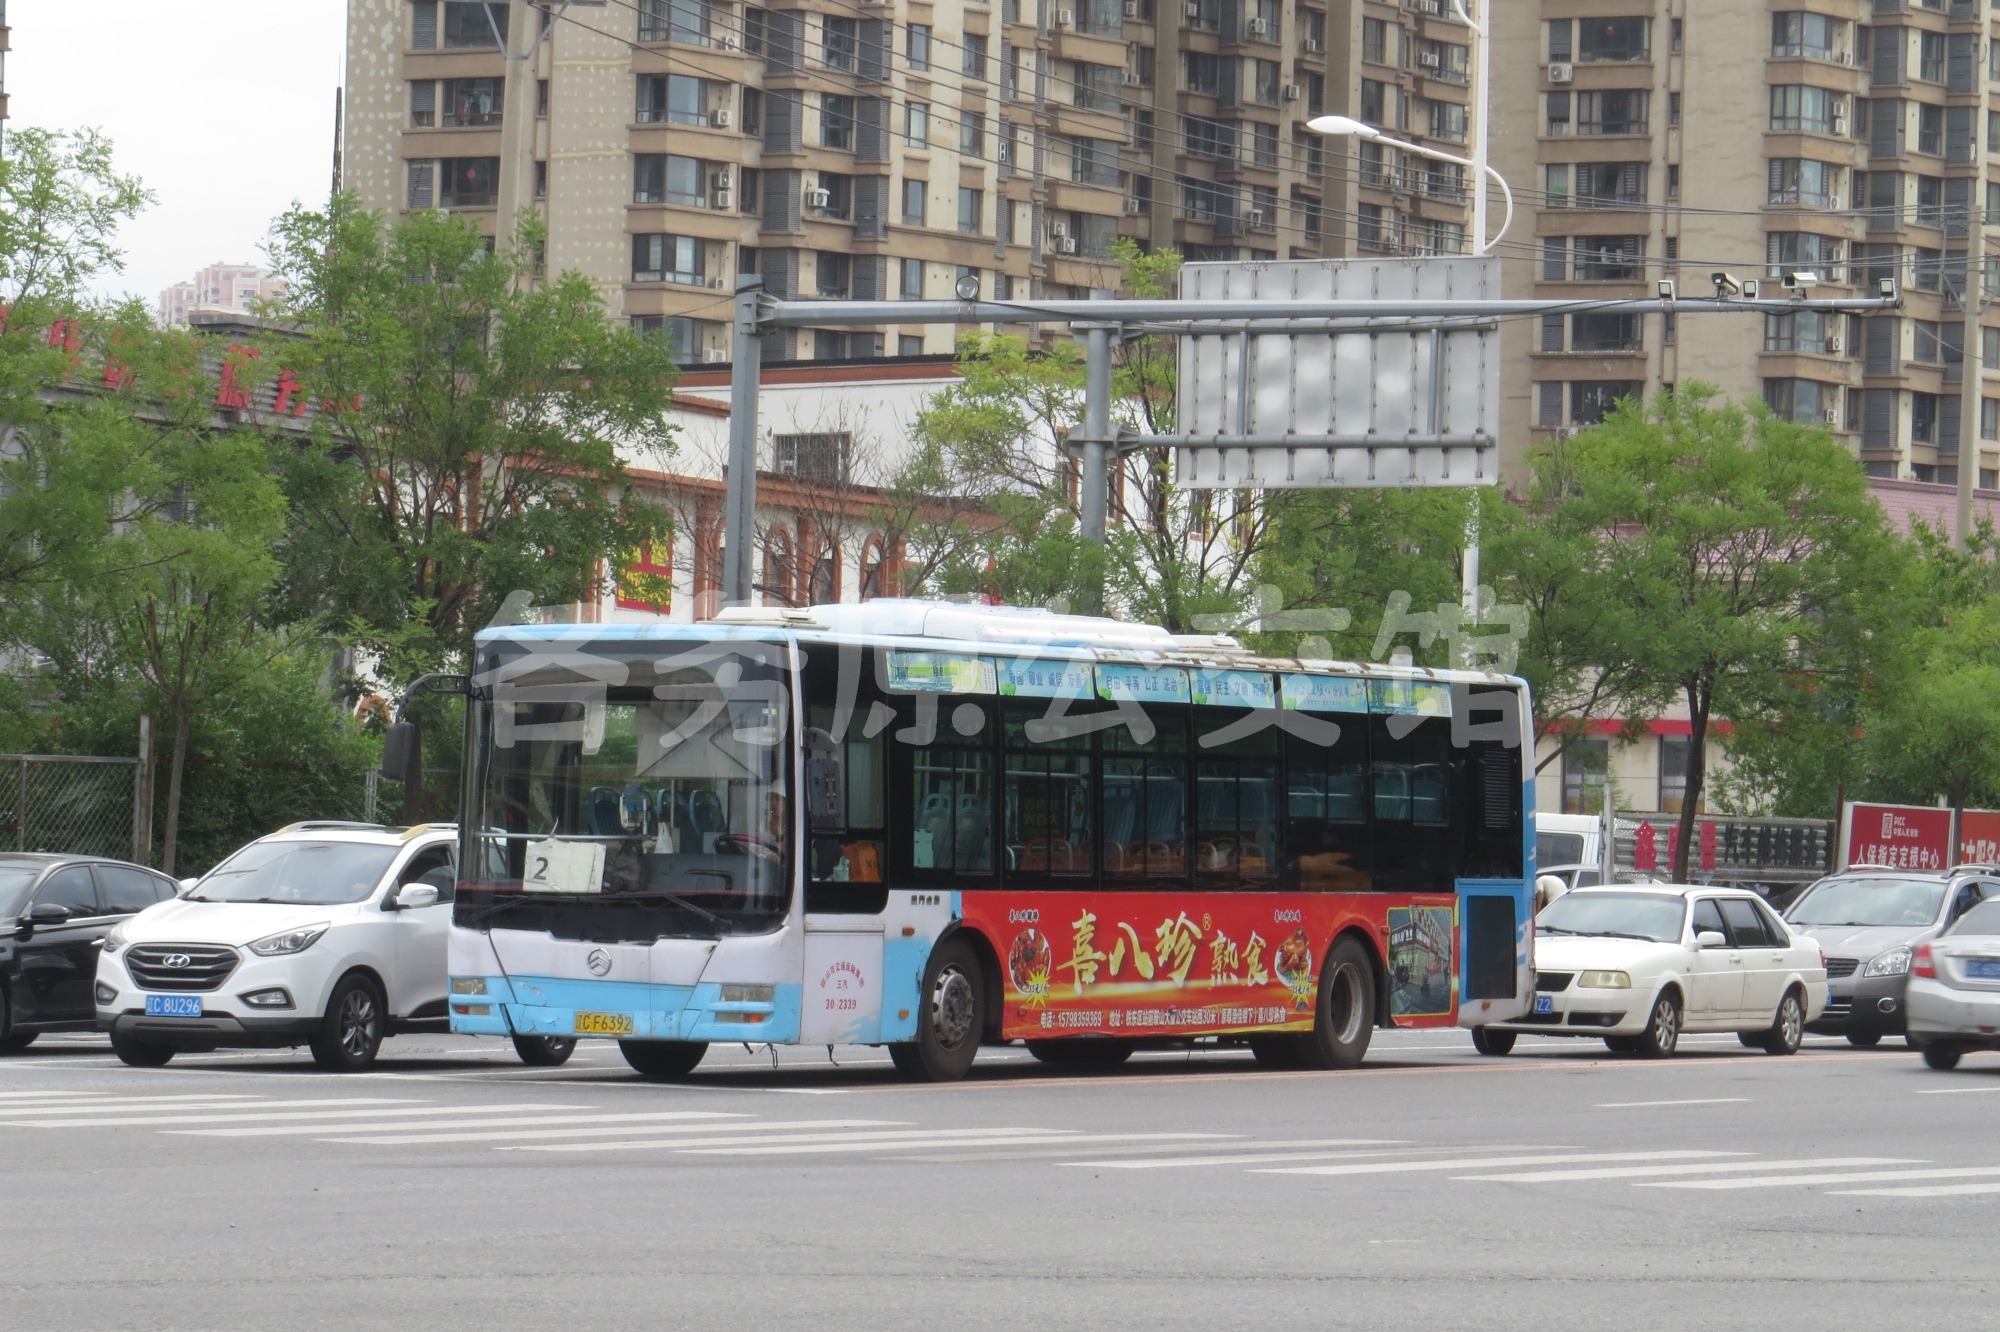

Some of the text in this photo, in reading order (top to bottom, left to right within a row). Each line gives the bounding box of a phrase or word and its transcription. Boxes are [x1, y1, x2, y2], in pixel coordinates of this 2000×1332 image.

[1106, 675, 1178, 693] 自由 平等 公正 法治
[1216, 680, 1231, 697] 民主
[1856, 843, 1940, 870] 人保指定定损中心
[533, 856, 549, 881] 2
